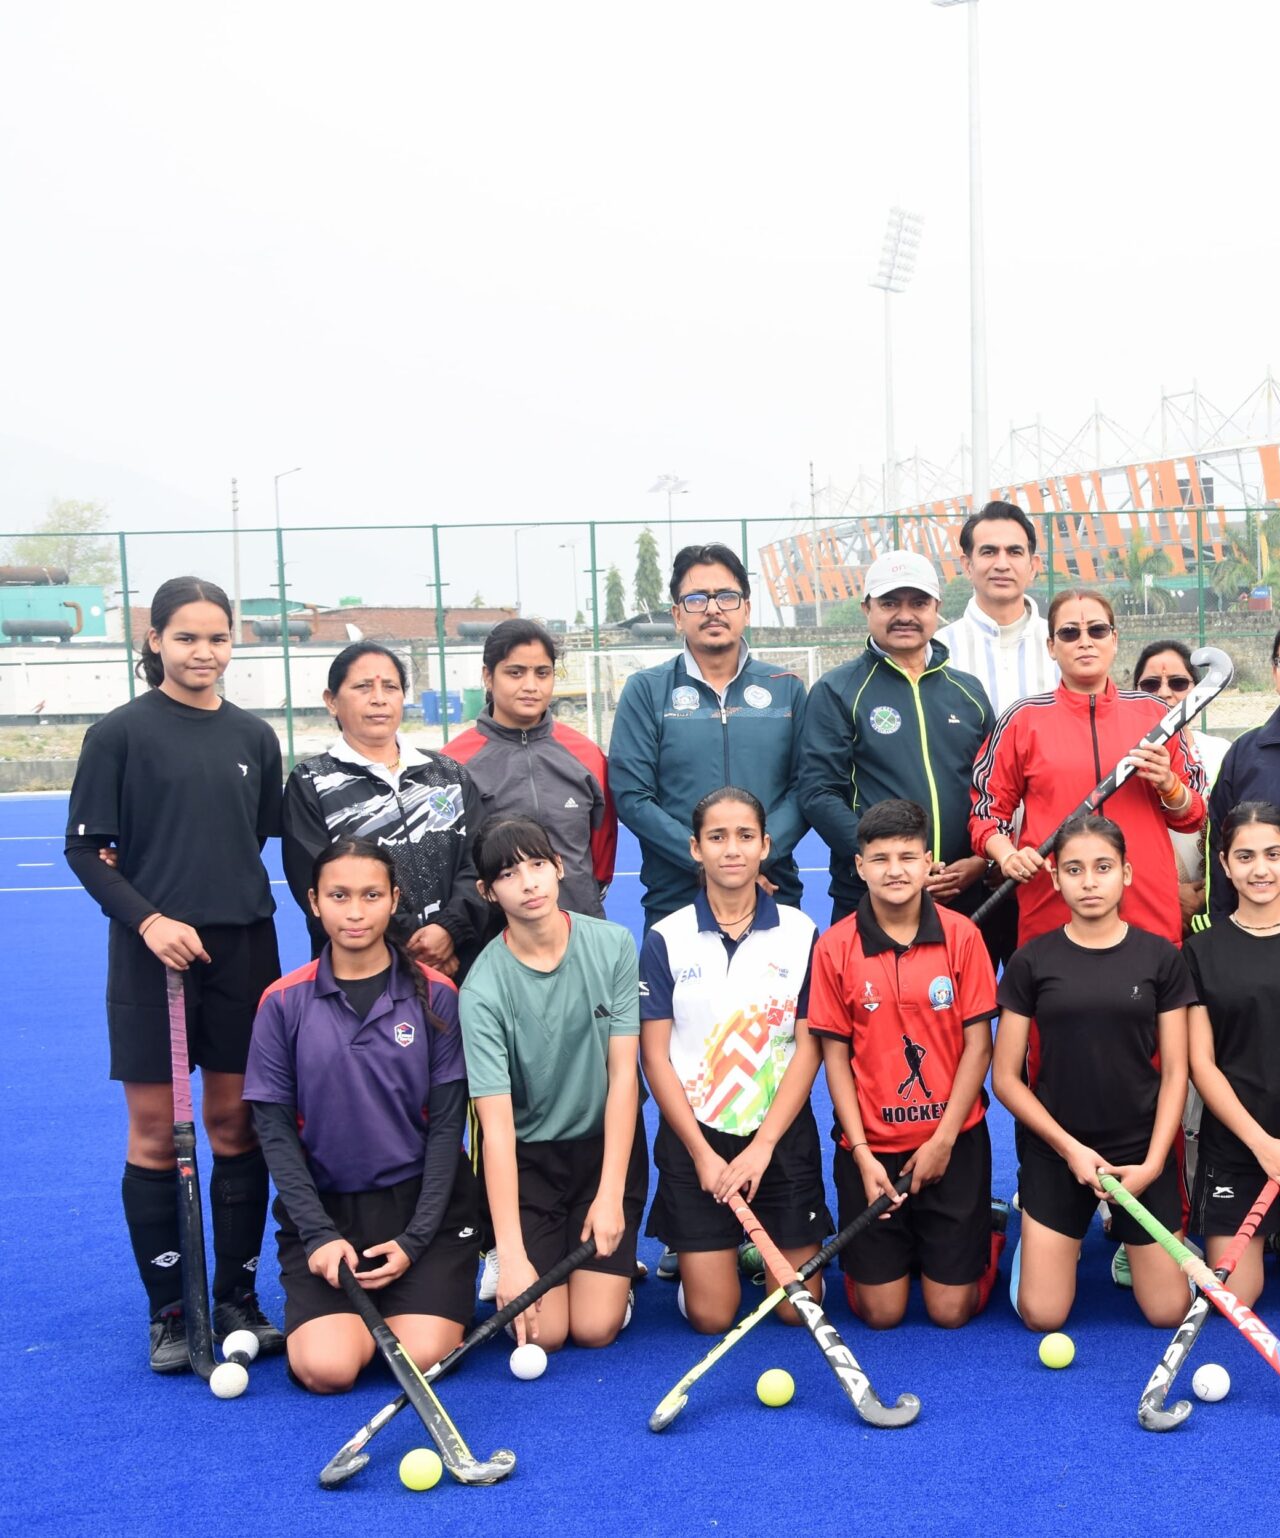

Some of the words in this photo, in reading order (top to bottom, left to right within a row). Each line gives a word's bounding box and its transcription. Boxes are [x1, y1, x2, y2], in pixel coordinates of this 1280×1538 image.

[881, 1101, 948, 1123] HOCKEY
[795, 1300, 870, 1406] ALFA
[1210, 1289, 1279, 1359] ALFA
